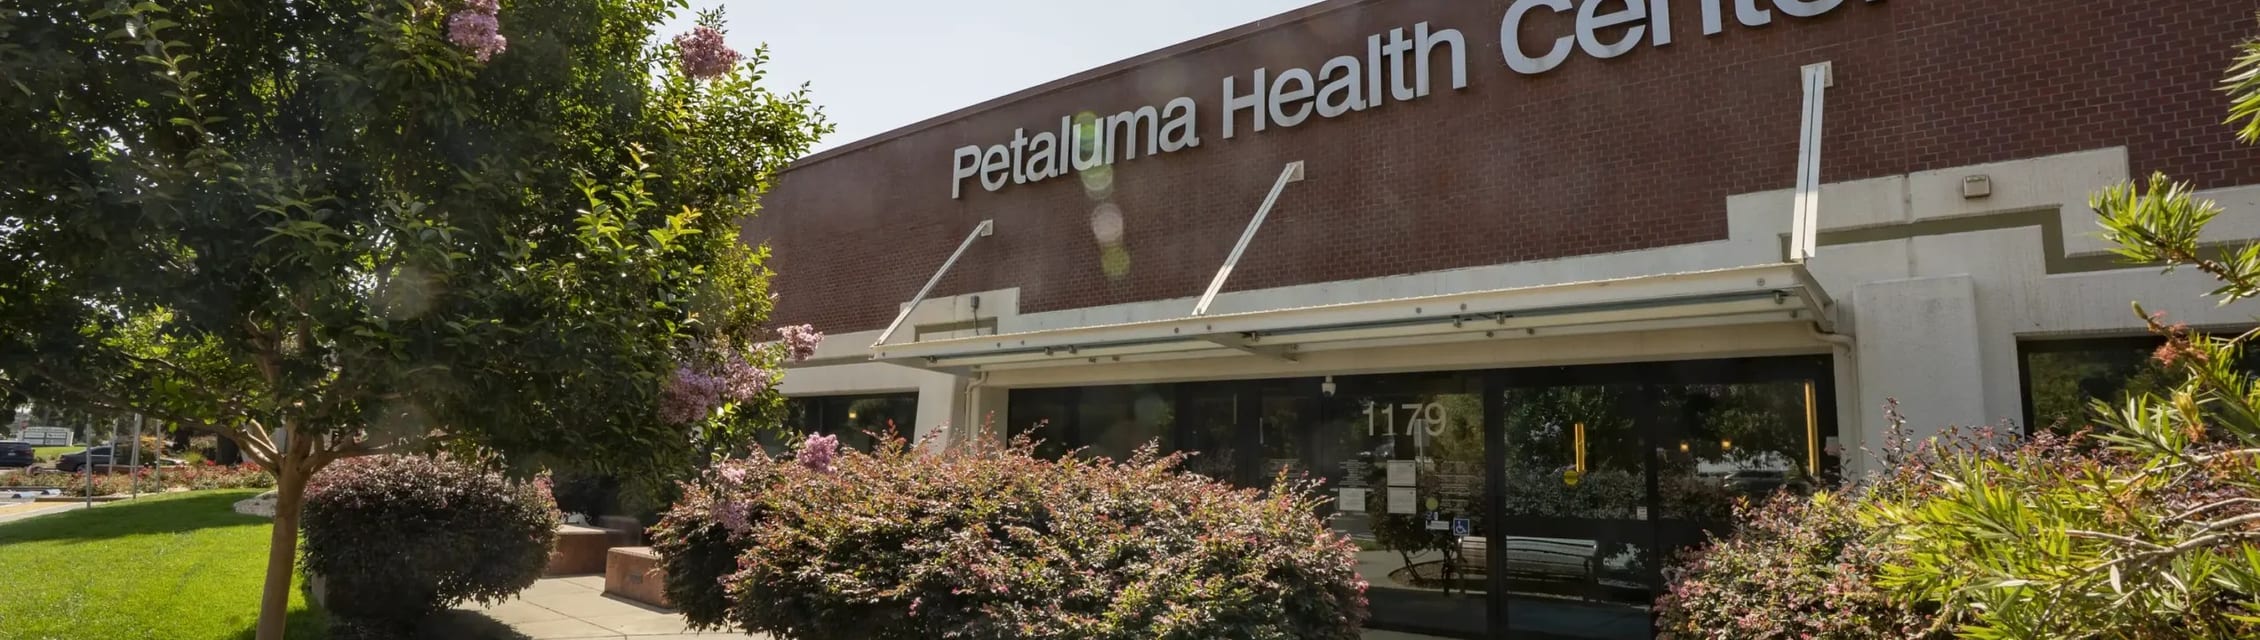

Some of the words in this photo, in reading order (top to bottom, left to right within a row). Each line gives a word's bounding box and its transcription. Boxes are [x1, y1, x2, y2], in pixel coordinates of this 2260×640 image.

[952, 96, 1199, 199] Petaluma
[1222, 21, 1467, 138] Health
[1362, 401, 1447, 436] 1179
